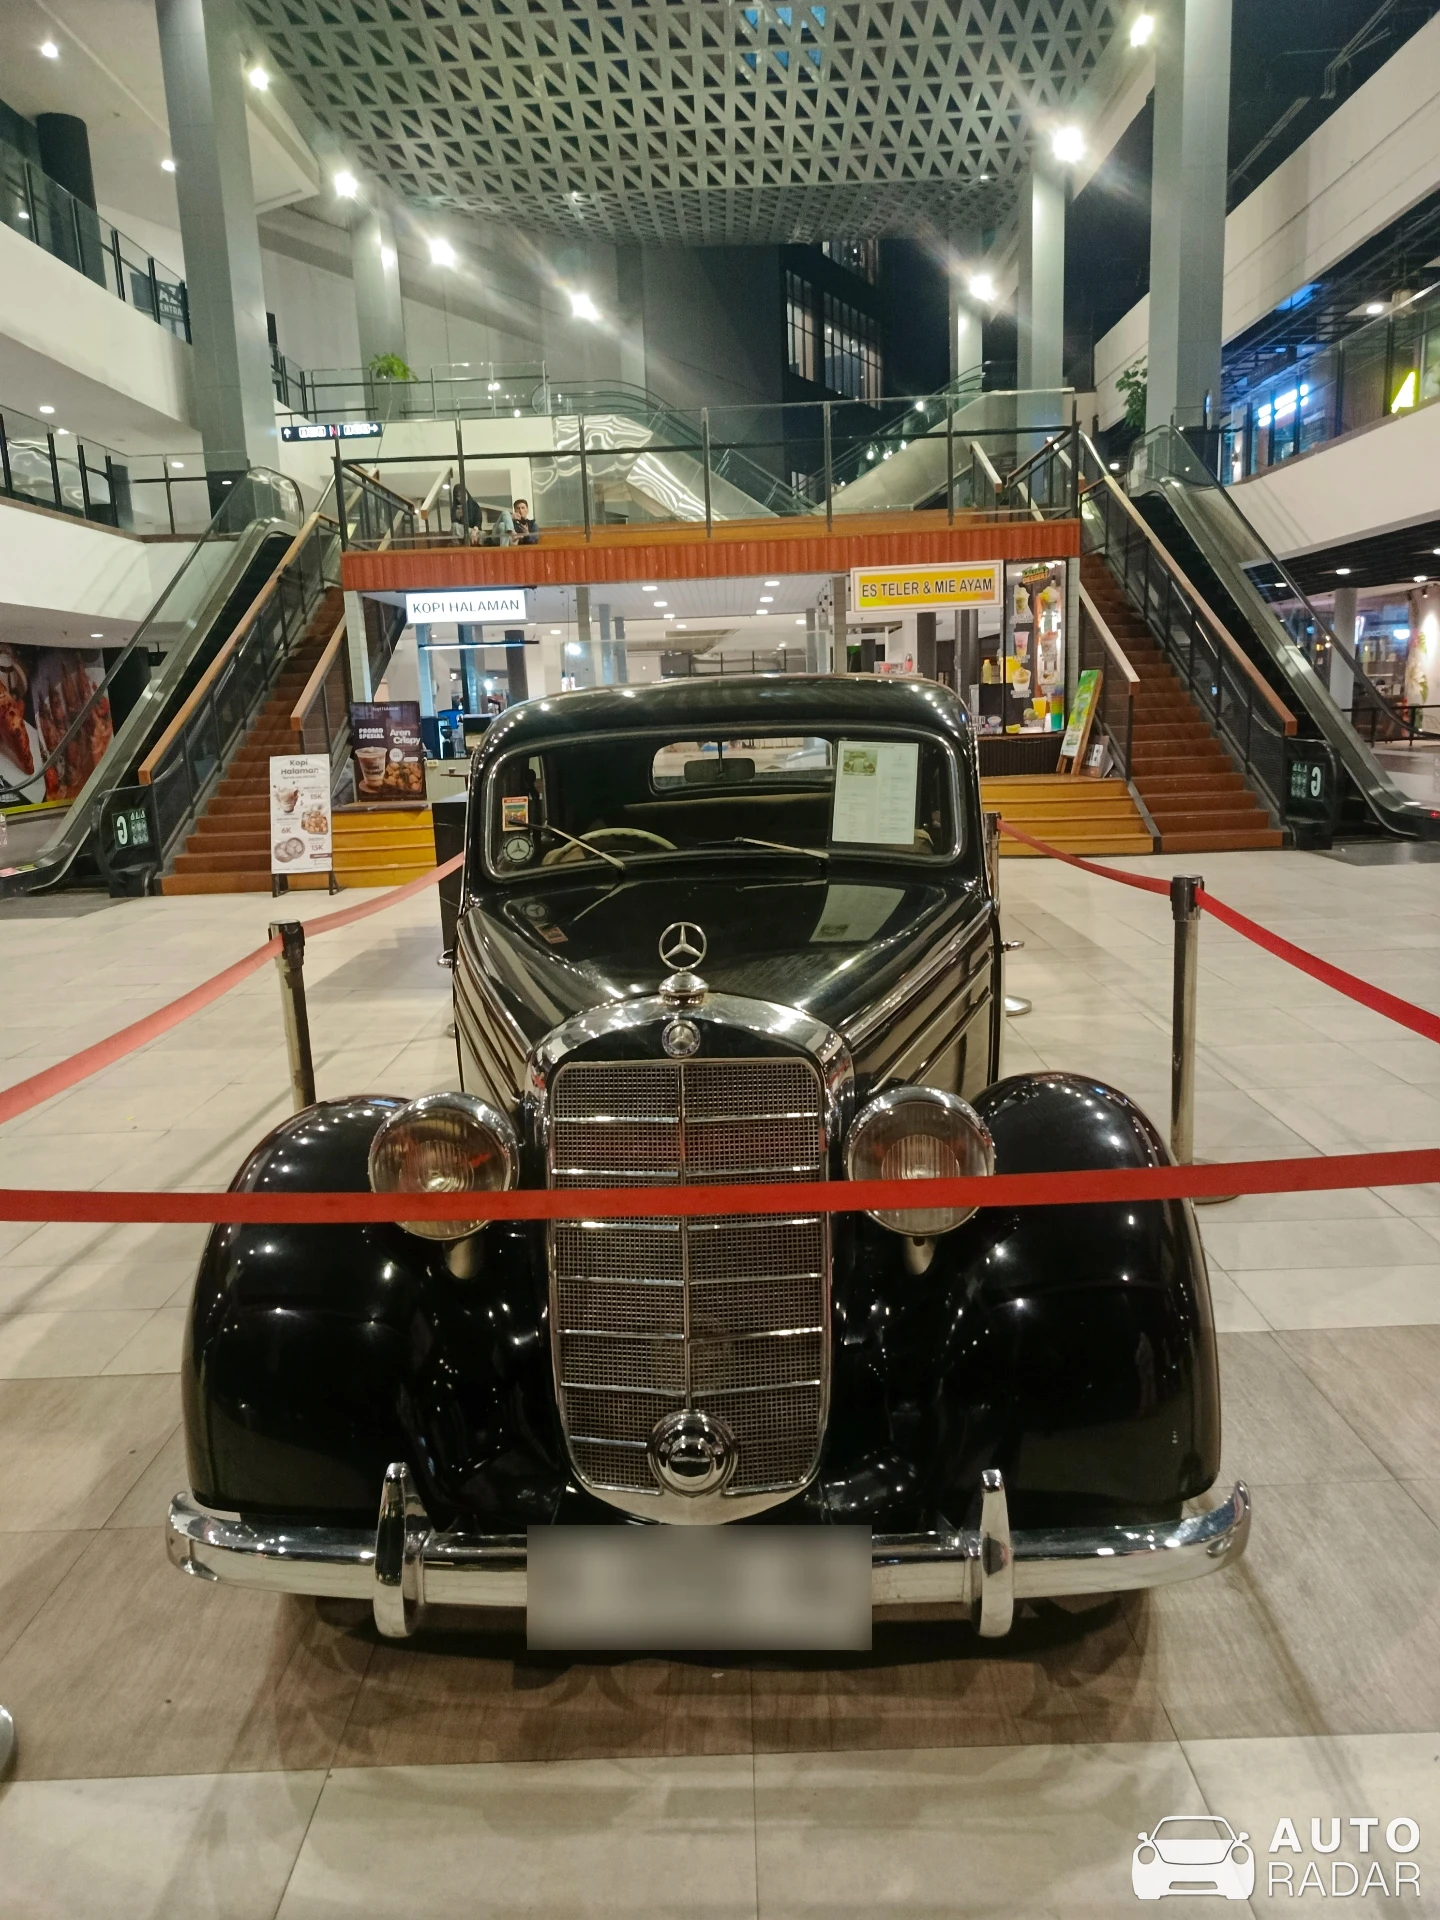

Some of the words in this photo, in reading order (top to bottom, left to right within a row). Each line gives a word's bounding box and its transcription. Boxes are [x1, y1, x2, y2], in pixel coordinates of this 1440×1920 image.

[862, 583, 877, 598] ES
[881, 581, 919, 596] TELER
[923, 581, 931, 594] &
[935, 579, 956, 593] MIE
[959, 578, 992, 592] AYAM
[413, 602, 445, 613] KOPI
[449, 600, 519, 612] HALAMAN
[393, 736, 421, 745] Crispy
[289, 758, 308, 767] Kopi
